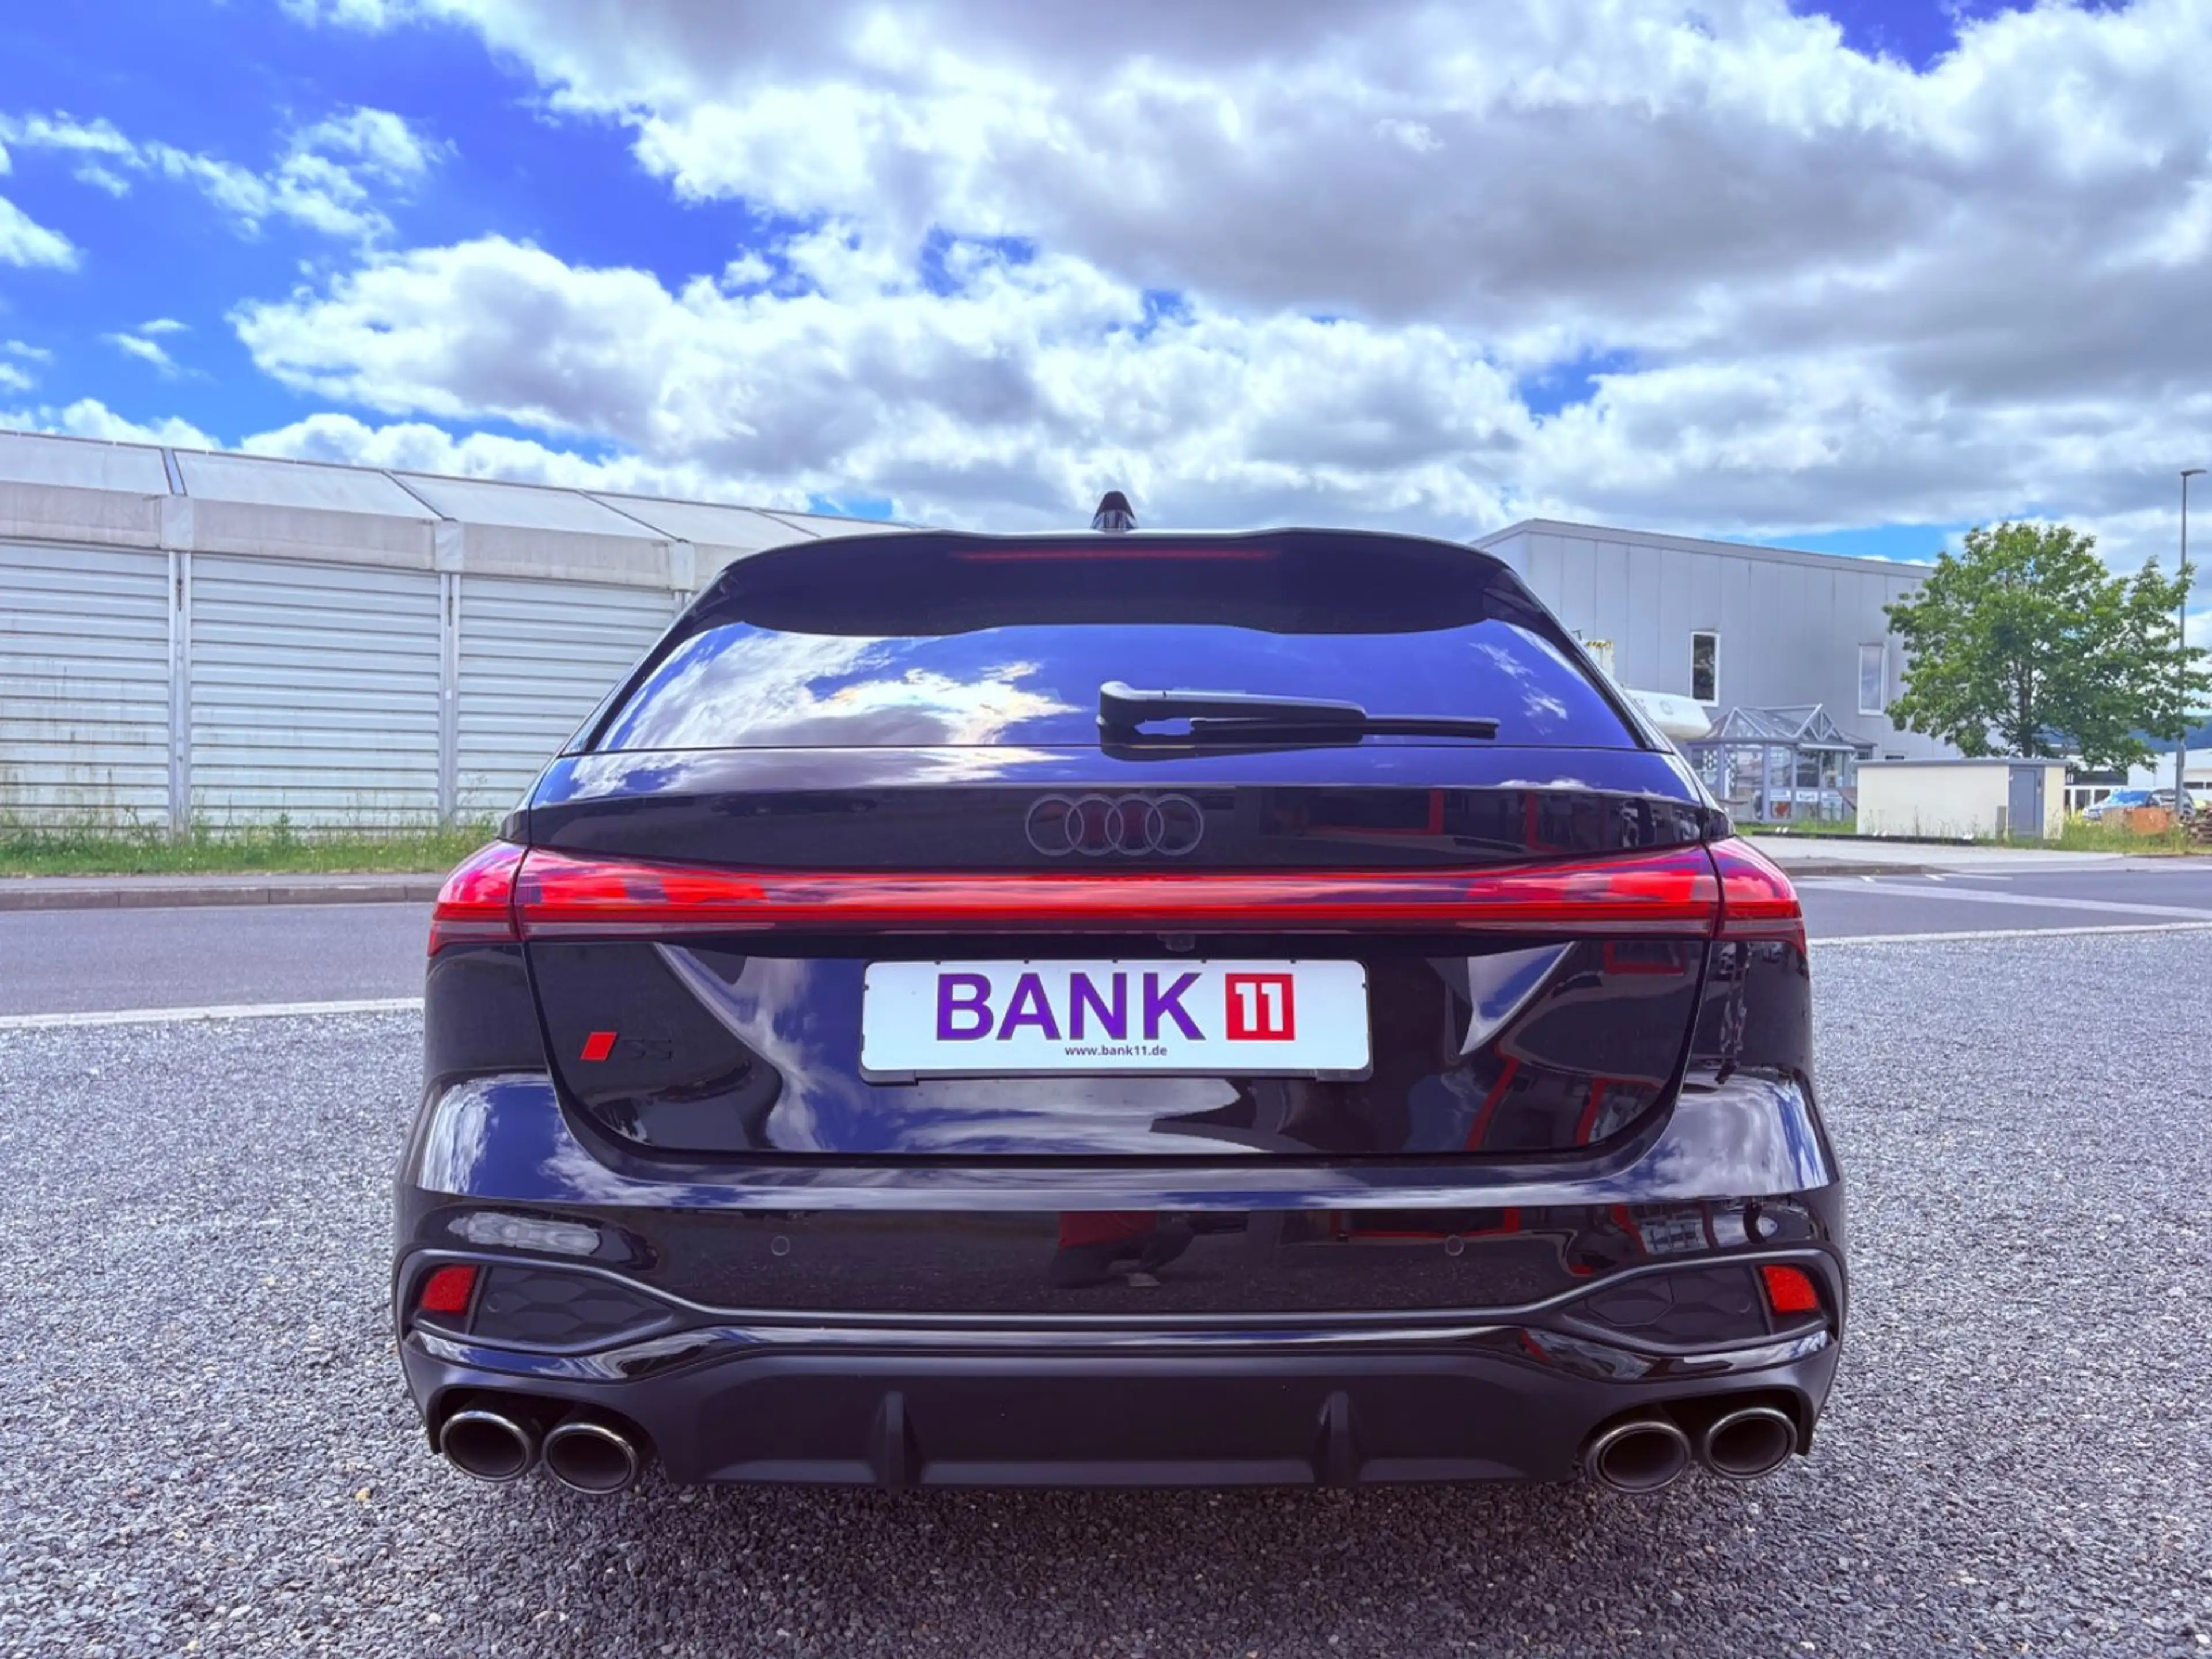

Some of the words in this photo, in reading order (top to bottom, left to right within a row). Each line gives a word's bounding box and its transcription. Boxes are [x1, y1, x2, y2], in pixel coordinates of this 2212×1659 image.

[937, 972, 1205, 1041] BANK
[1234, 981, 1285, 1032] 11
[1064, 1044, 1168, 1056] www.bank11.de
